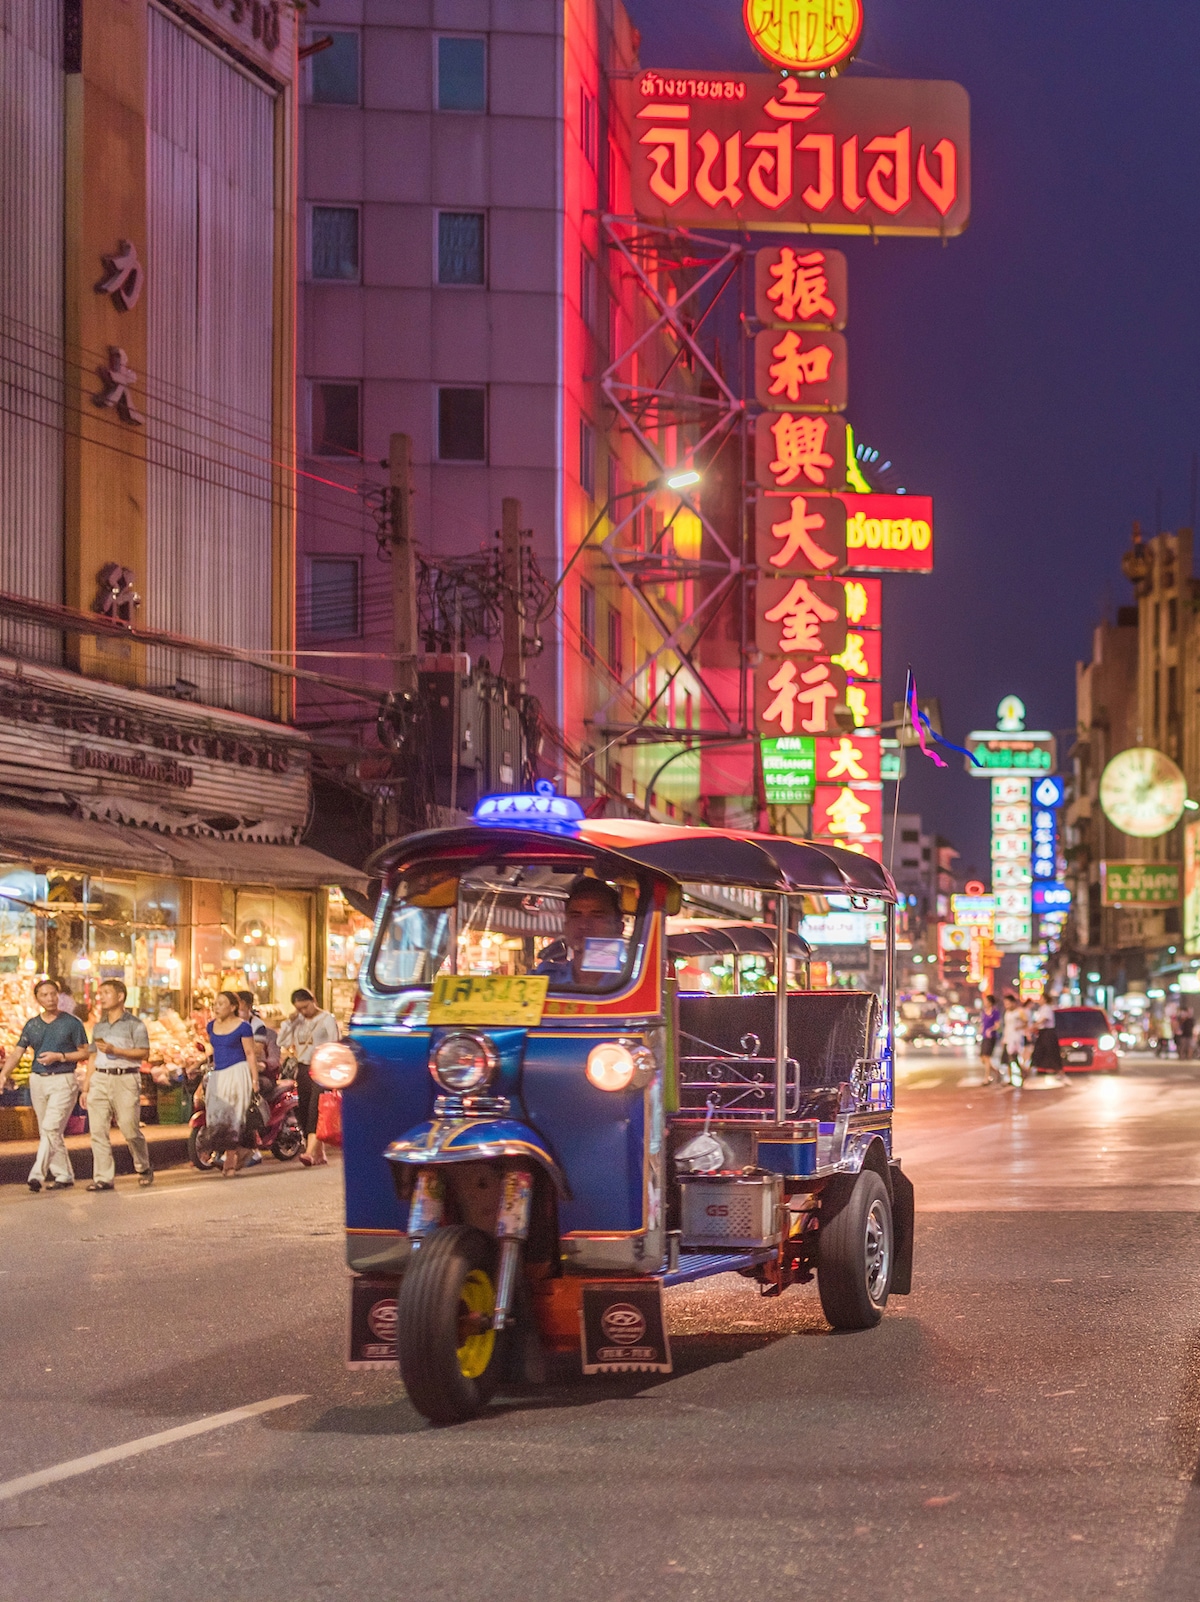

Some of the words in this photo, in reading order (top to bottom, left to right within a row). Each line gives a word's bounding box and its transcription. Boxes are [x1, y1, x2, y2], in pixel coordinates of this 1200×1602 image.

[640, 72, 746, 100] ห้างขายทอง
[761, 246, 840, 734] 振和興大金行
[776, 737, 802, 750] ATM
[763, 756, 813, 769] EXCHANGE
[493, 797, 554, 812] TAXI
[706, 1204, 728, 1217] GS
